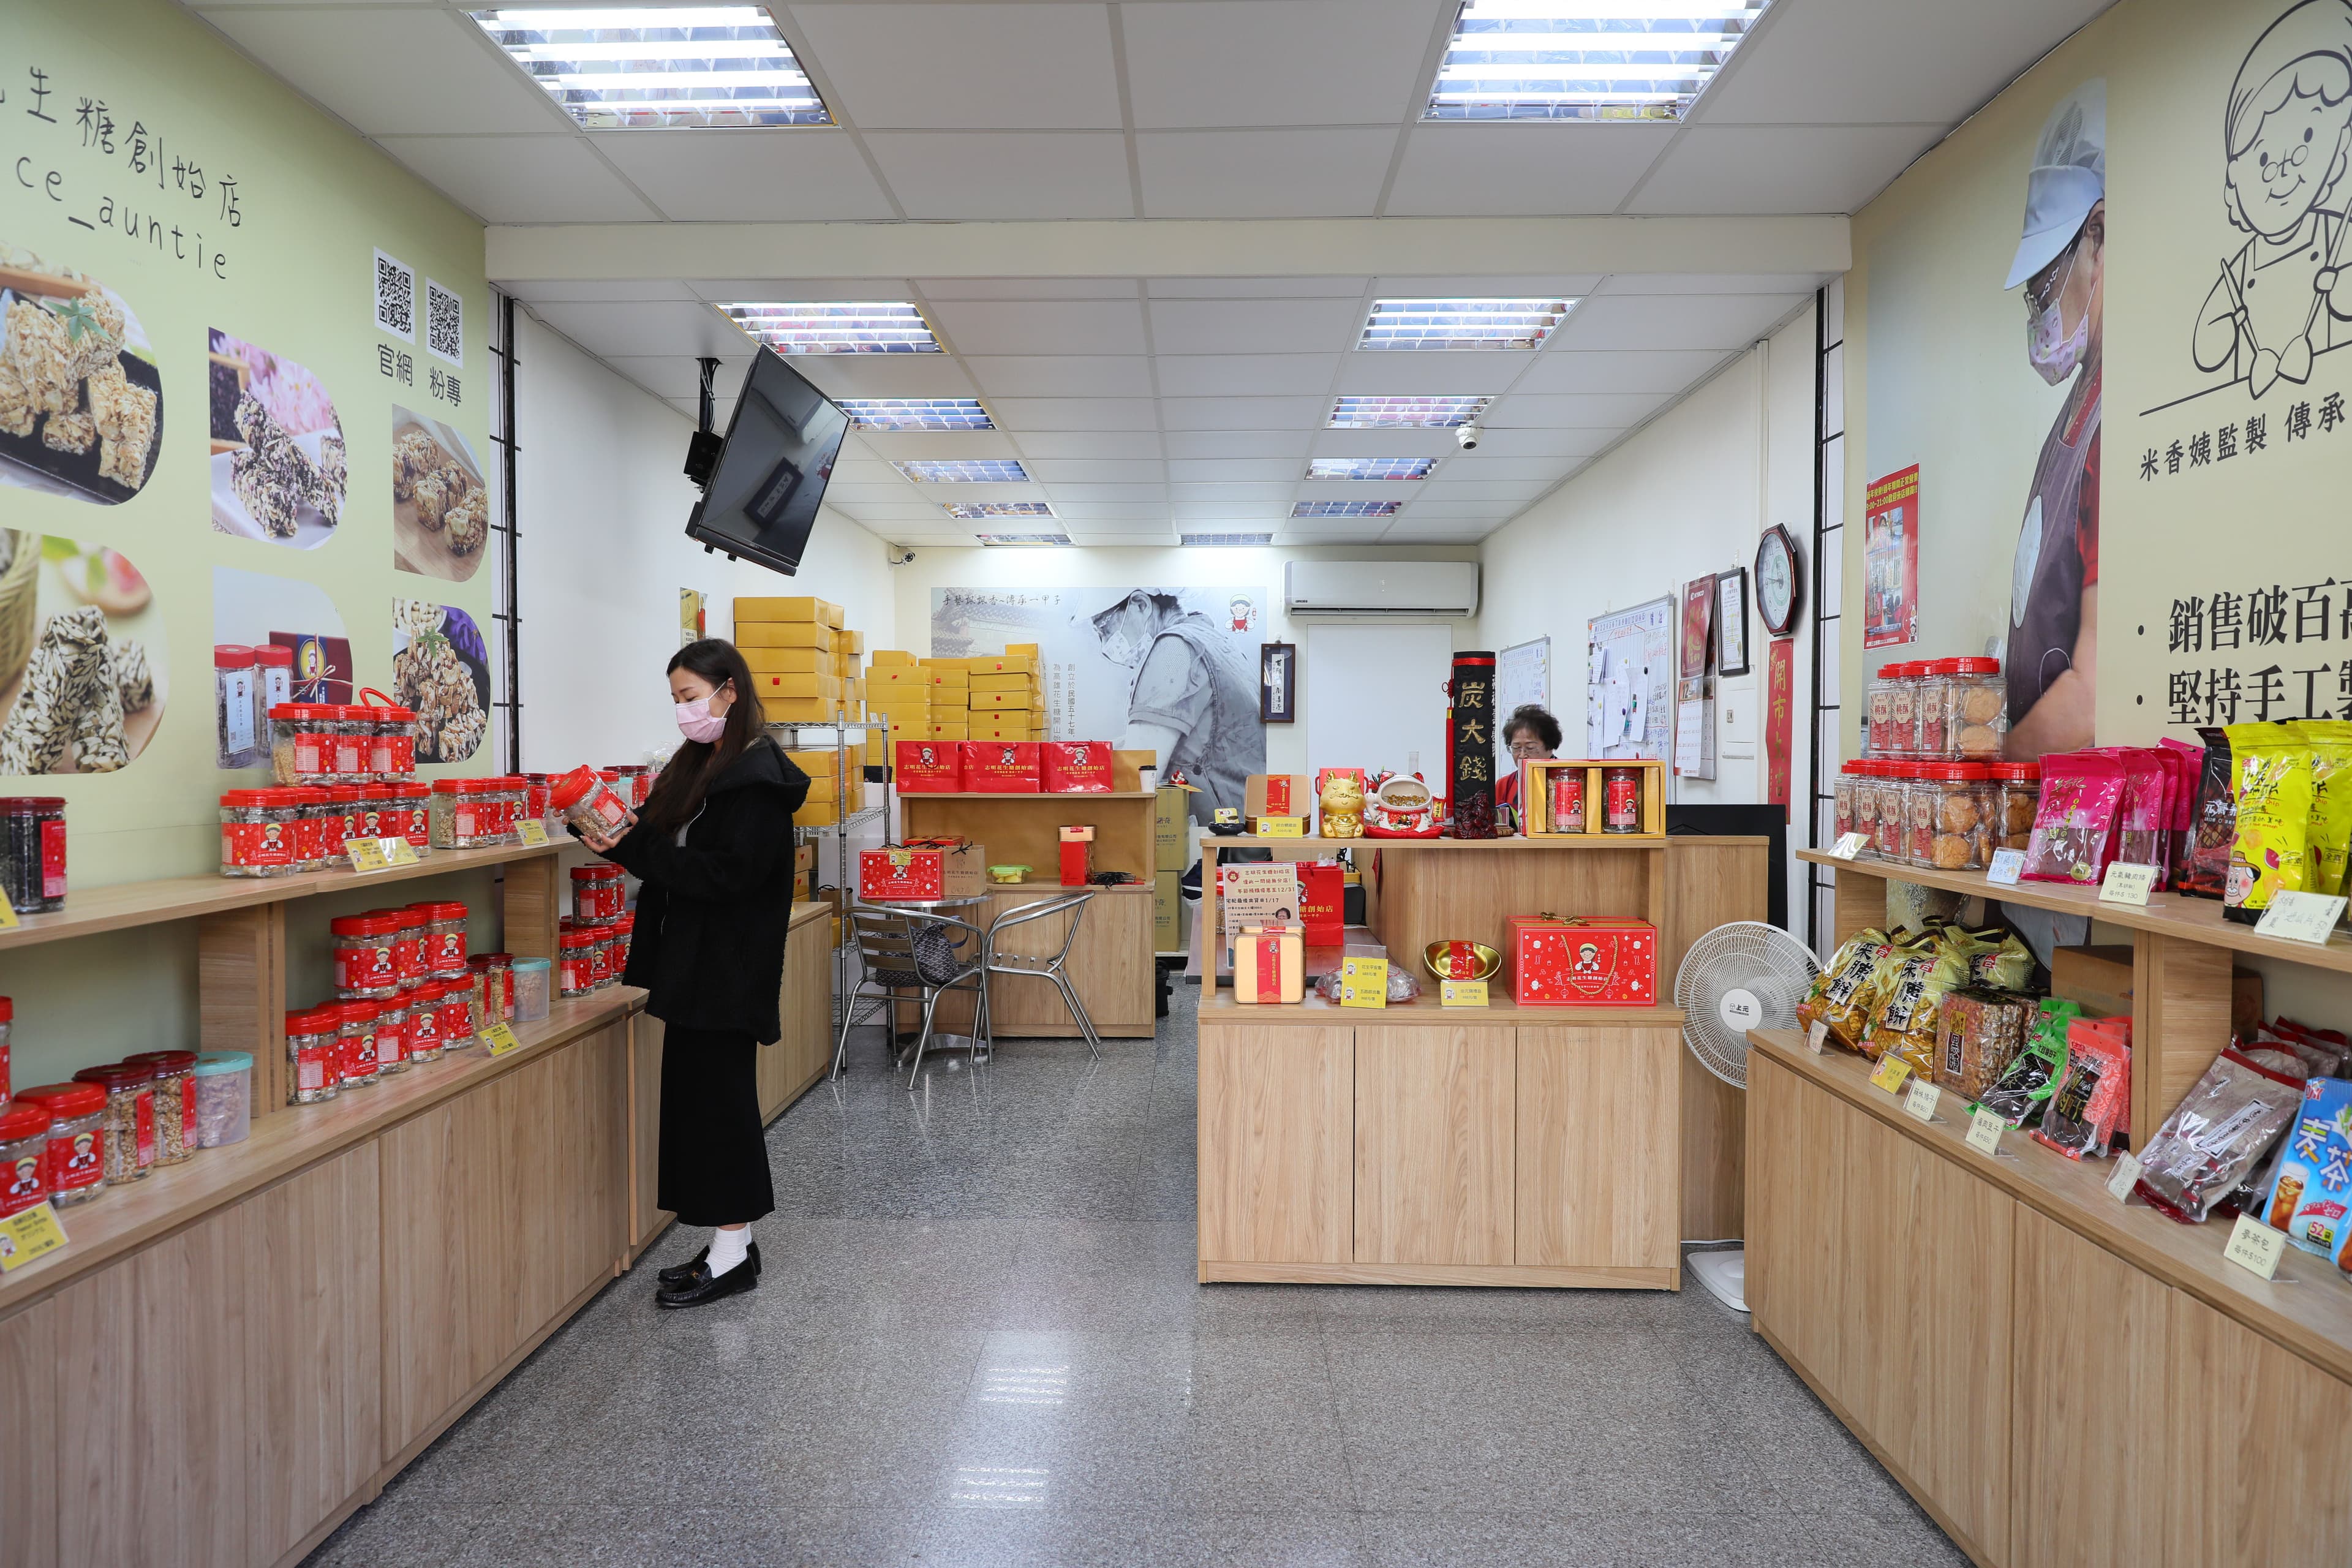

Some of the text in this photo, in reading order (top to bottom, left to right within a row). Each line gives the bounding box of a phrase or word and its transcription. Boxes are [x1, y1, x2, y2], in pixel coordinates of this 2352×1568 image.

[0, 66, 243, 228] 生糖創始店
[377, 344, 414, 388] 官網
[429, 366, 462, 408] 粉專
[2139, 391, 2346, 482] 米香姨監製 傳承
[1768, 545, 1774, 556] 11
[1775, 538, 1781, 549] 12
[1765, 580, 1769, 589] 9
[1768, 597, 1772, 607] 8
[1774, 609, 1777, 619] 7
[1458, 682, 1487, 782] 炭大錢
[1773, 658, 1787, 797] 開市大吉
[2079, 1080, 2090, 1091] High
